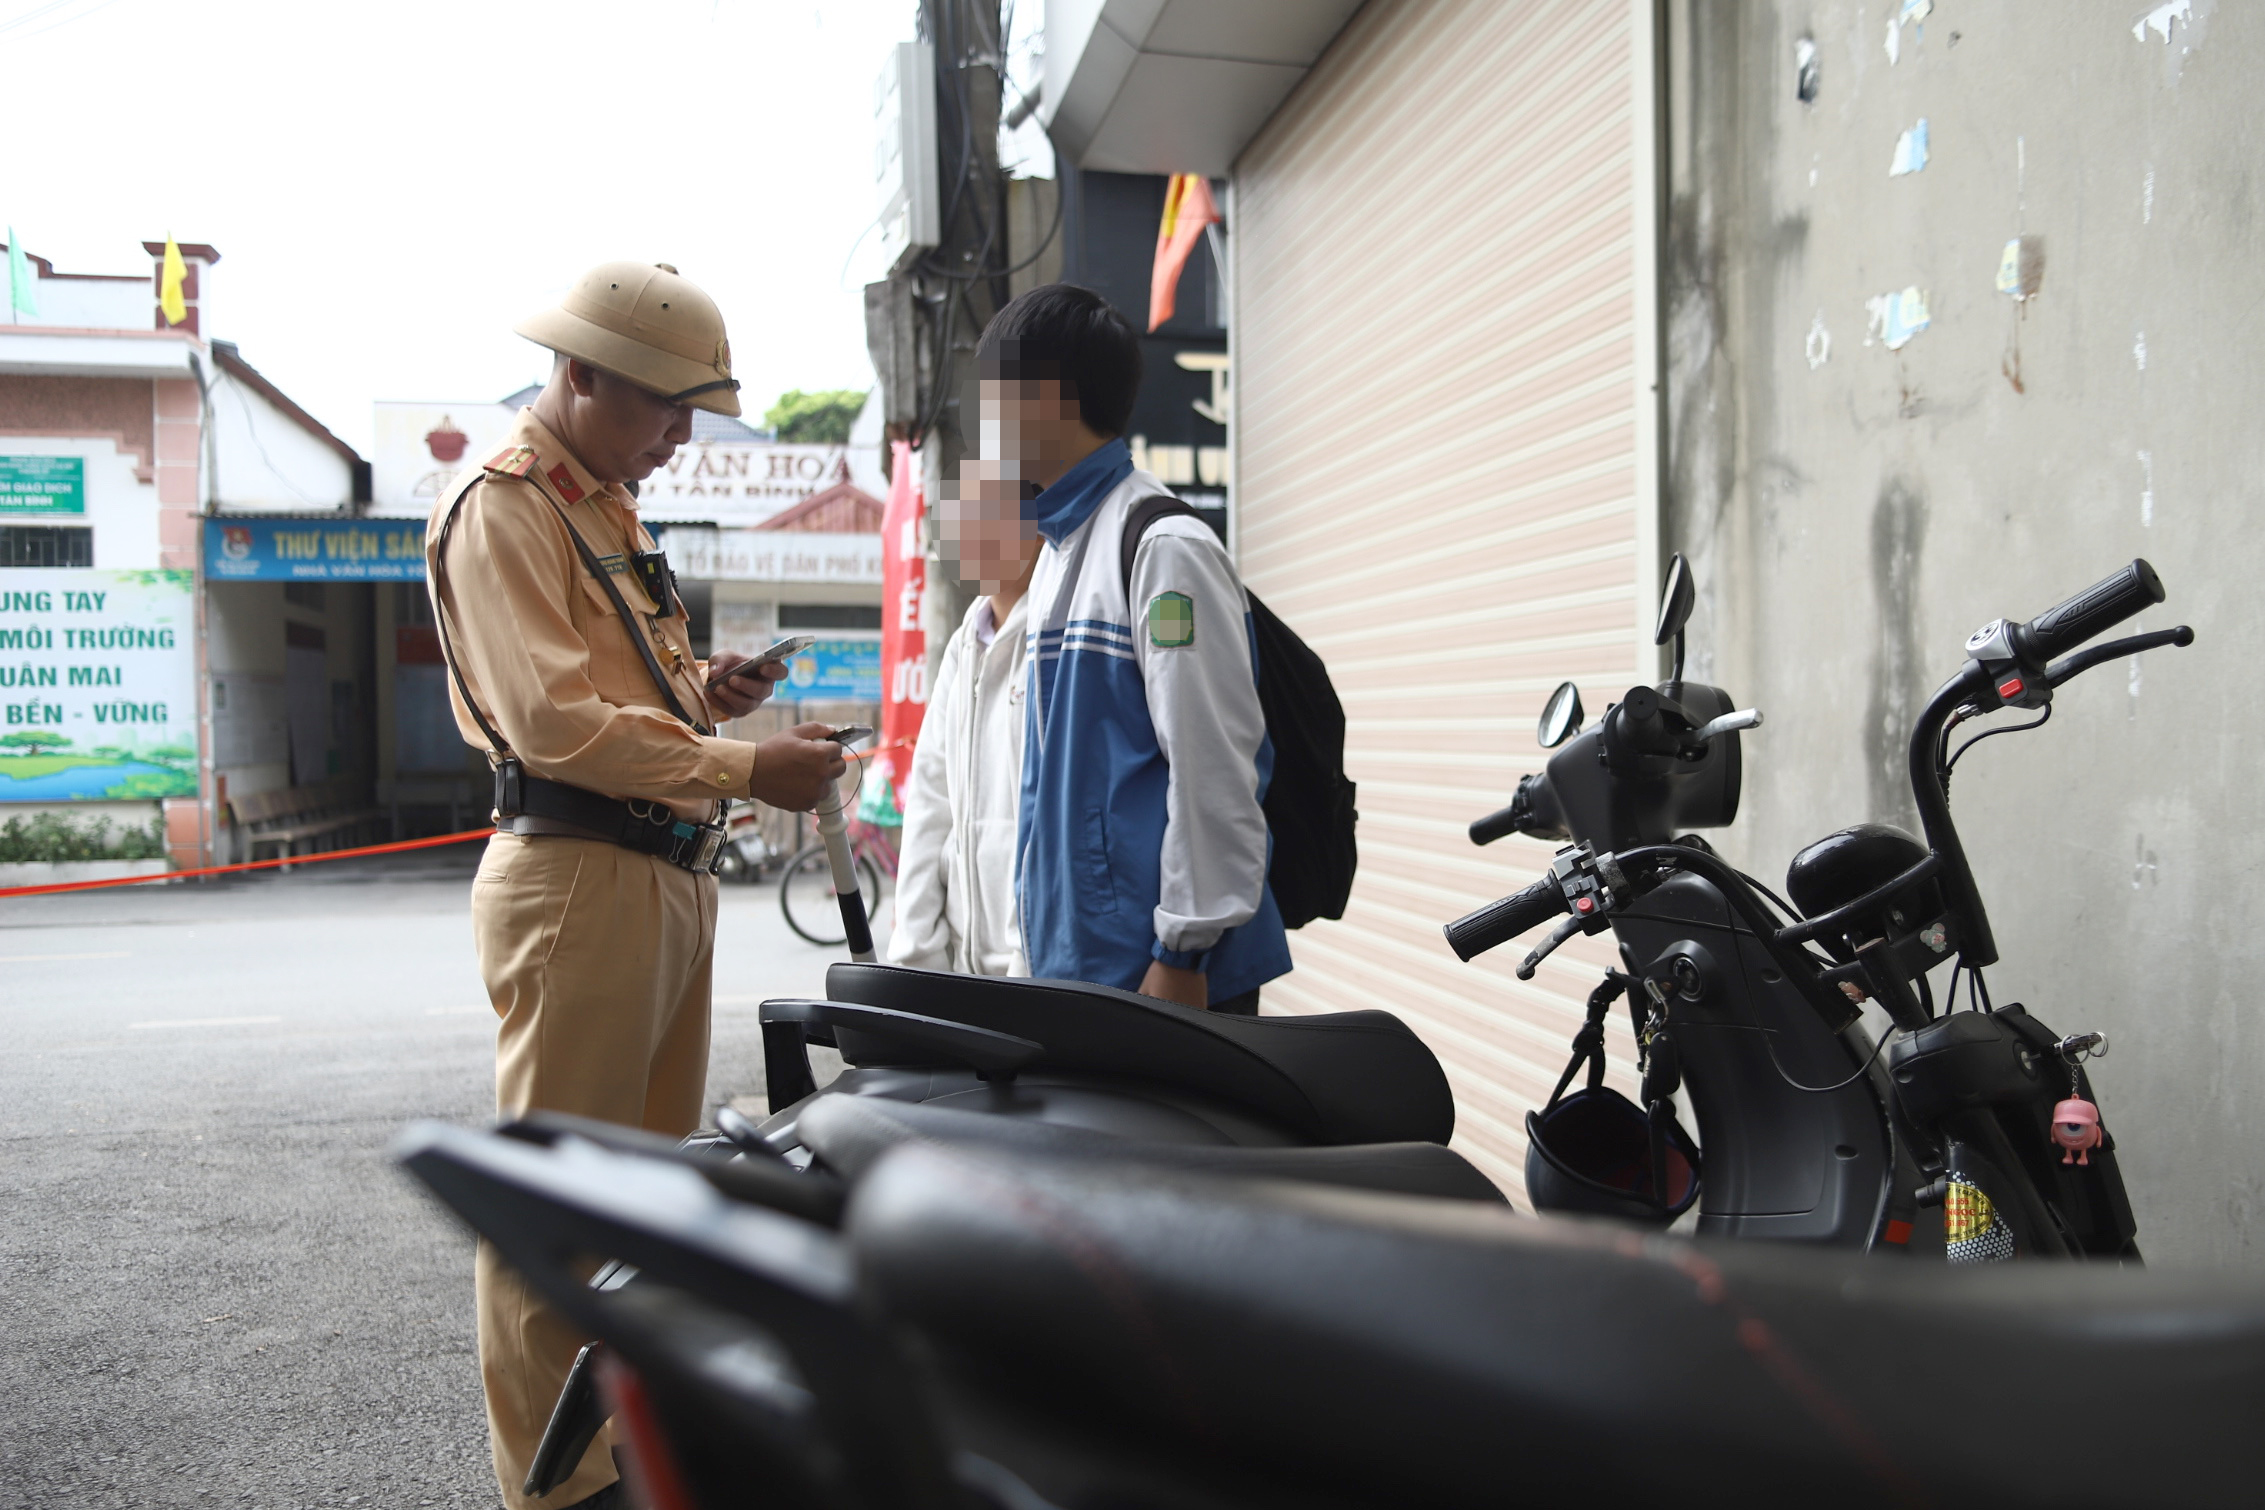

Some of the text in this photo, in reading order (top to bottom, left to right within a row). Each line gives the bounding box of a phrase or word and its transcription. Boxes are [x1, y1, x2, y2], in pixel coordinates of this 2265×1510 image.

[273, 530, 320, 560] THƯ
[325, 528, 379, 564] VIỆN
[62, 592, 107, 611] TAY
[0, 621, 175, 649] MÔI TRƯỜNG
[68, 666, 122, 686] MAI
[93, 698, 168, 723] VỮNG
